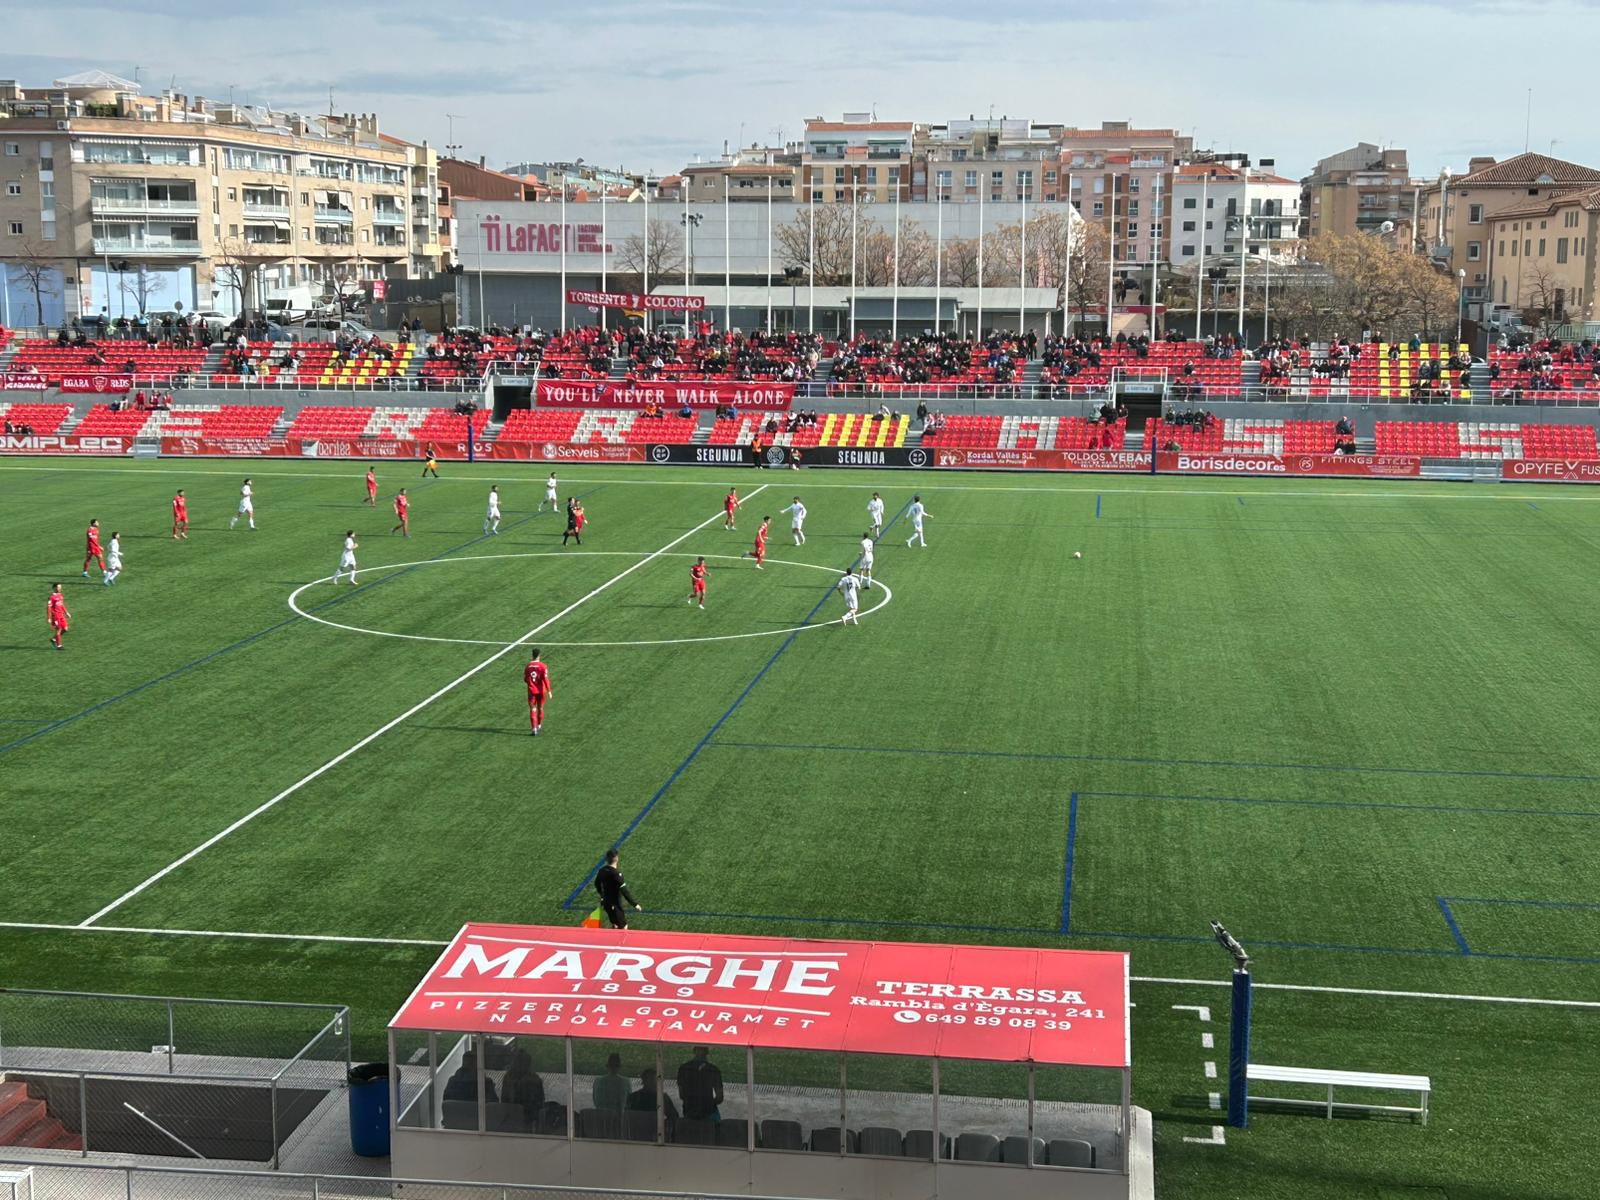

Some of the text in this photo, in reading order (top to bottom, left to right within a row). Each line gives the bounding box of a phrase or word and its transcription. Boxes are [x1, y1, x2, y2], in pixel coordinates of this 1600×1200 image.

[63, 379, 130, 387] EGARA REDS
[545, 386, 784, 405] YOU'LL NEVER WALK ALONE
[558, 446, 599, 458] Serveis
[696, 447, 743, 462] SEGUNDA
[838, 450, 885, 464] SEGUNDA
[1062, 452, 1105, 461] TOLDOS
[1177, 456, 1286, 472] Borisdecor.es
[1321, 456, 1414, 465] FITTINGS STEEL
[440, 943, 840, 996] MARGHE
[570, 982, 694, 997] 1889
[876, 980, 1086, 1005] TERRASSA
[430, 1001, 815, 1029] PIZZERIA GOURMET
[849, 995, 945, 1010] Rambla
[1065, 1007, 1105, 1019] 241
[489, 1013, 738, 1035] NAPOLETANA
[925, 1012, 1072, 1031] 649 89 08 39
